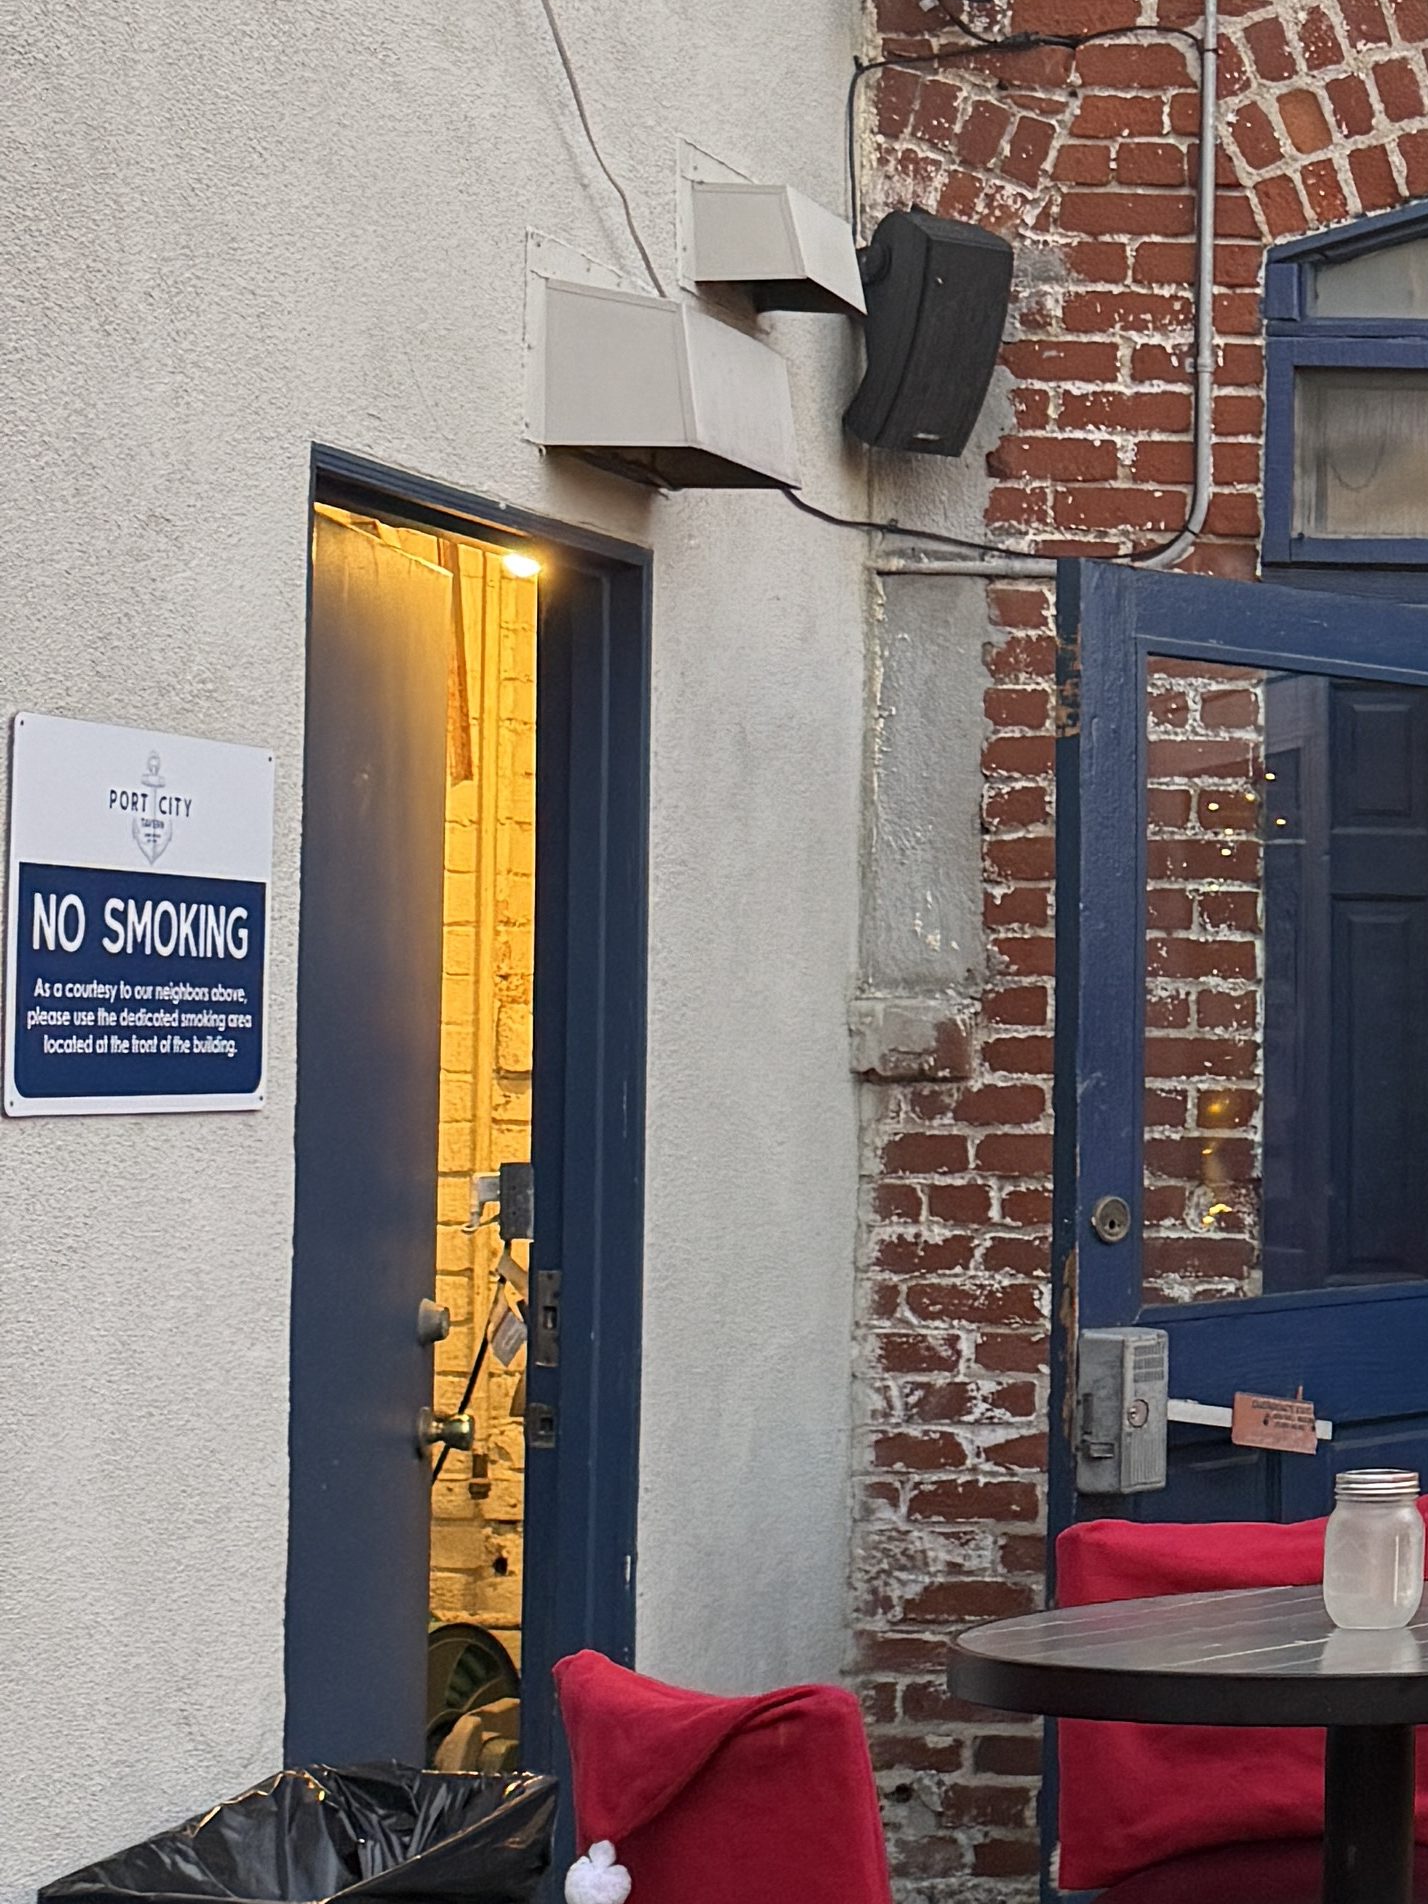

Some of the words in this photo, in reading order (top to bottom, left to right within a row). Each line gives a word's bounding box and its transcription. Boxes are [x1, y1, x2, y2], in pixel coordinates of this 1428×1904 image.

[109, 790, 149, 814] PORT
[158, 795, 193, 818] CITY
[32, 892, 86, 953] NO
[102, 897, 249, 960] SMOKING
[34, 977, 51, 998] As
[53, 983, 64, 998] a
[65, 979, 118, 1003] courtesy
[119, 980, 132, 1000] to
[134, 984, 153, 1000] our
[155, 982, 210, 1005] neighbors
[211, 983, 248, 1005] above,
[27, 1007, 71, 1030] please
[73, 1010, 95, 1027] use
[97, 1007, 117, 1027] the
[119, 1008, 179, 1028] dedicated
[180, 1009, 225, 1031] smoking
[227, 1013, 252, 1029] area
[44, 1034, 93, 1054] located
[96, 1036, 109, 1054] at
[110, 1035, 129, 1054] the
[131, 1035, 158, 1054] front
[159, 1035, 172, 1054] of
[172, 1035, 190, 1054] the
[192, 1035, 238, 1057] building.
